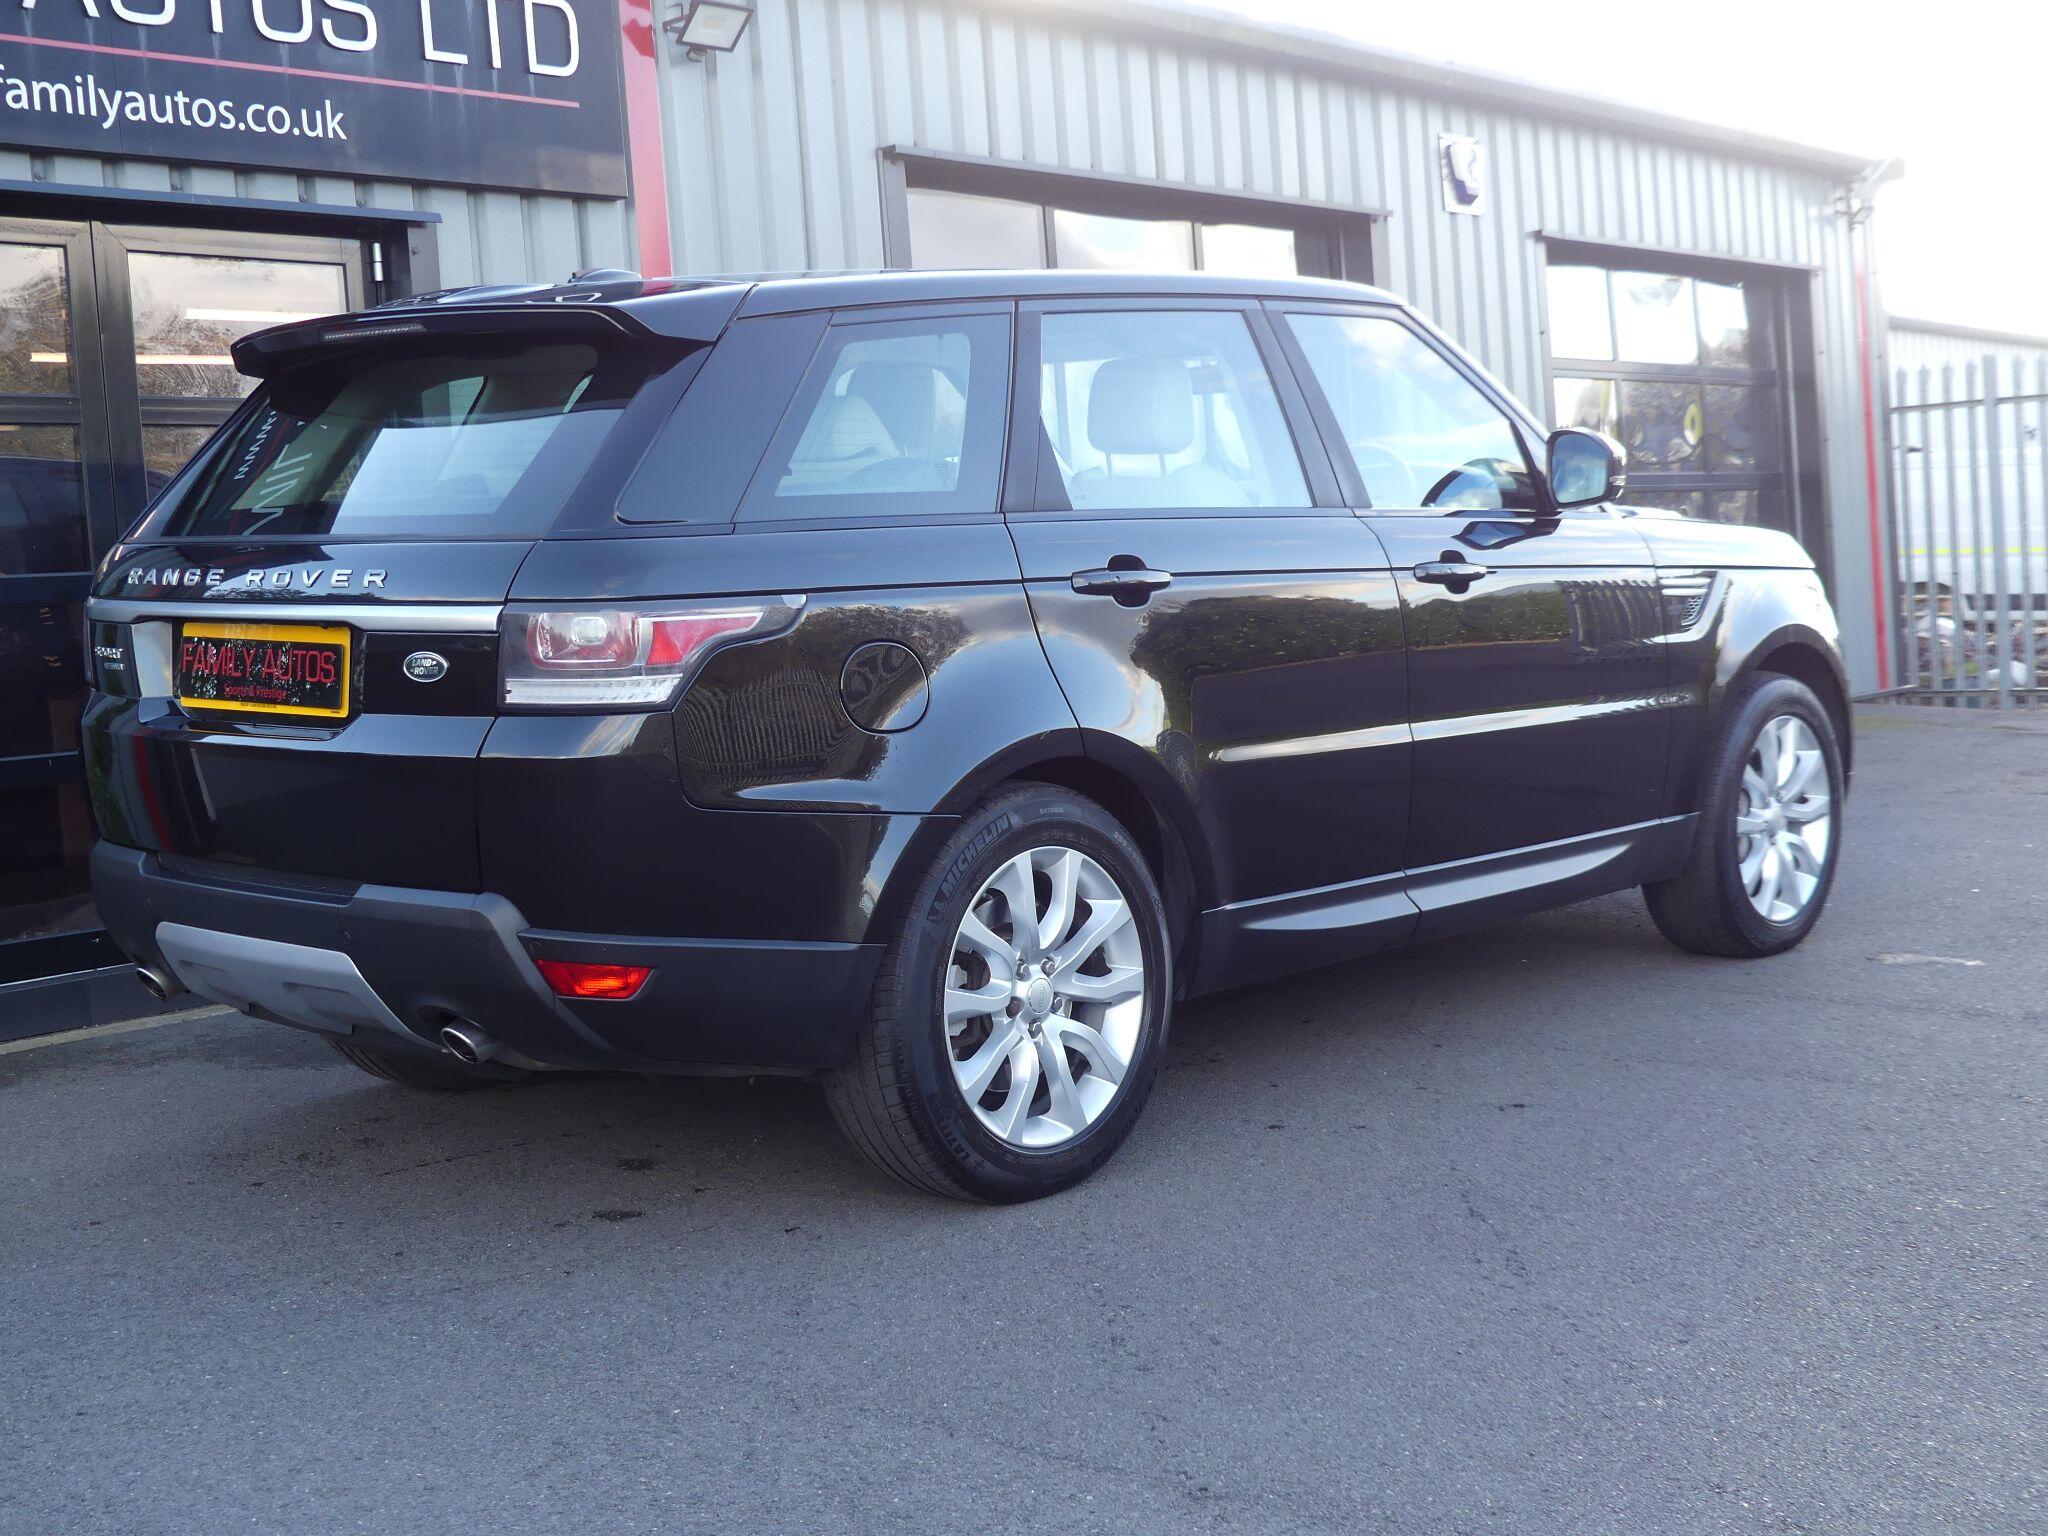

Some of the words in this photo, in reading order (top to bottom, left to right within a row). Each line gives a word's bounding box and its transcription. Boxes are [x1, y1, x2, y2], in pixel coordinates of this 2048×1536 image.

[127, 567, 225, 587] RANGE
[245, 568, 388, 590] ROVER
[181, 642, 257, 679] FAMILY
[262, 648, 337, 684] AUTOS
[224, 684, 249, 698] Sports
[256, 685, 288, 701] Prestige
[941, 812, 1012, 899] MICHELIN
